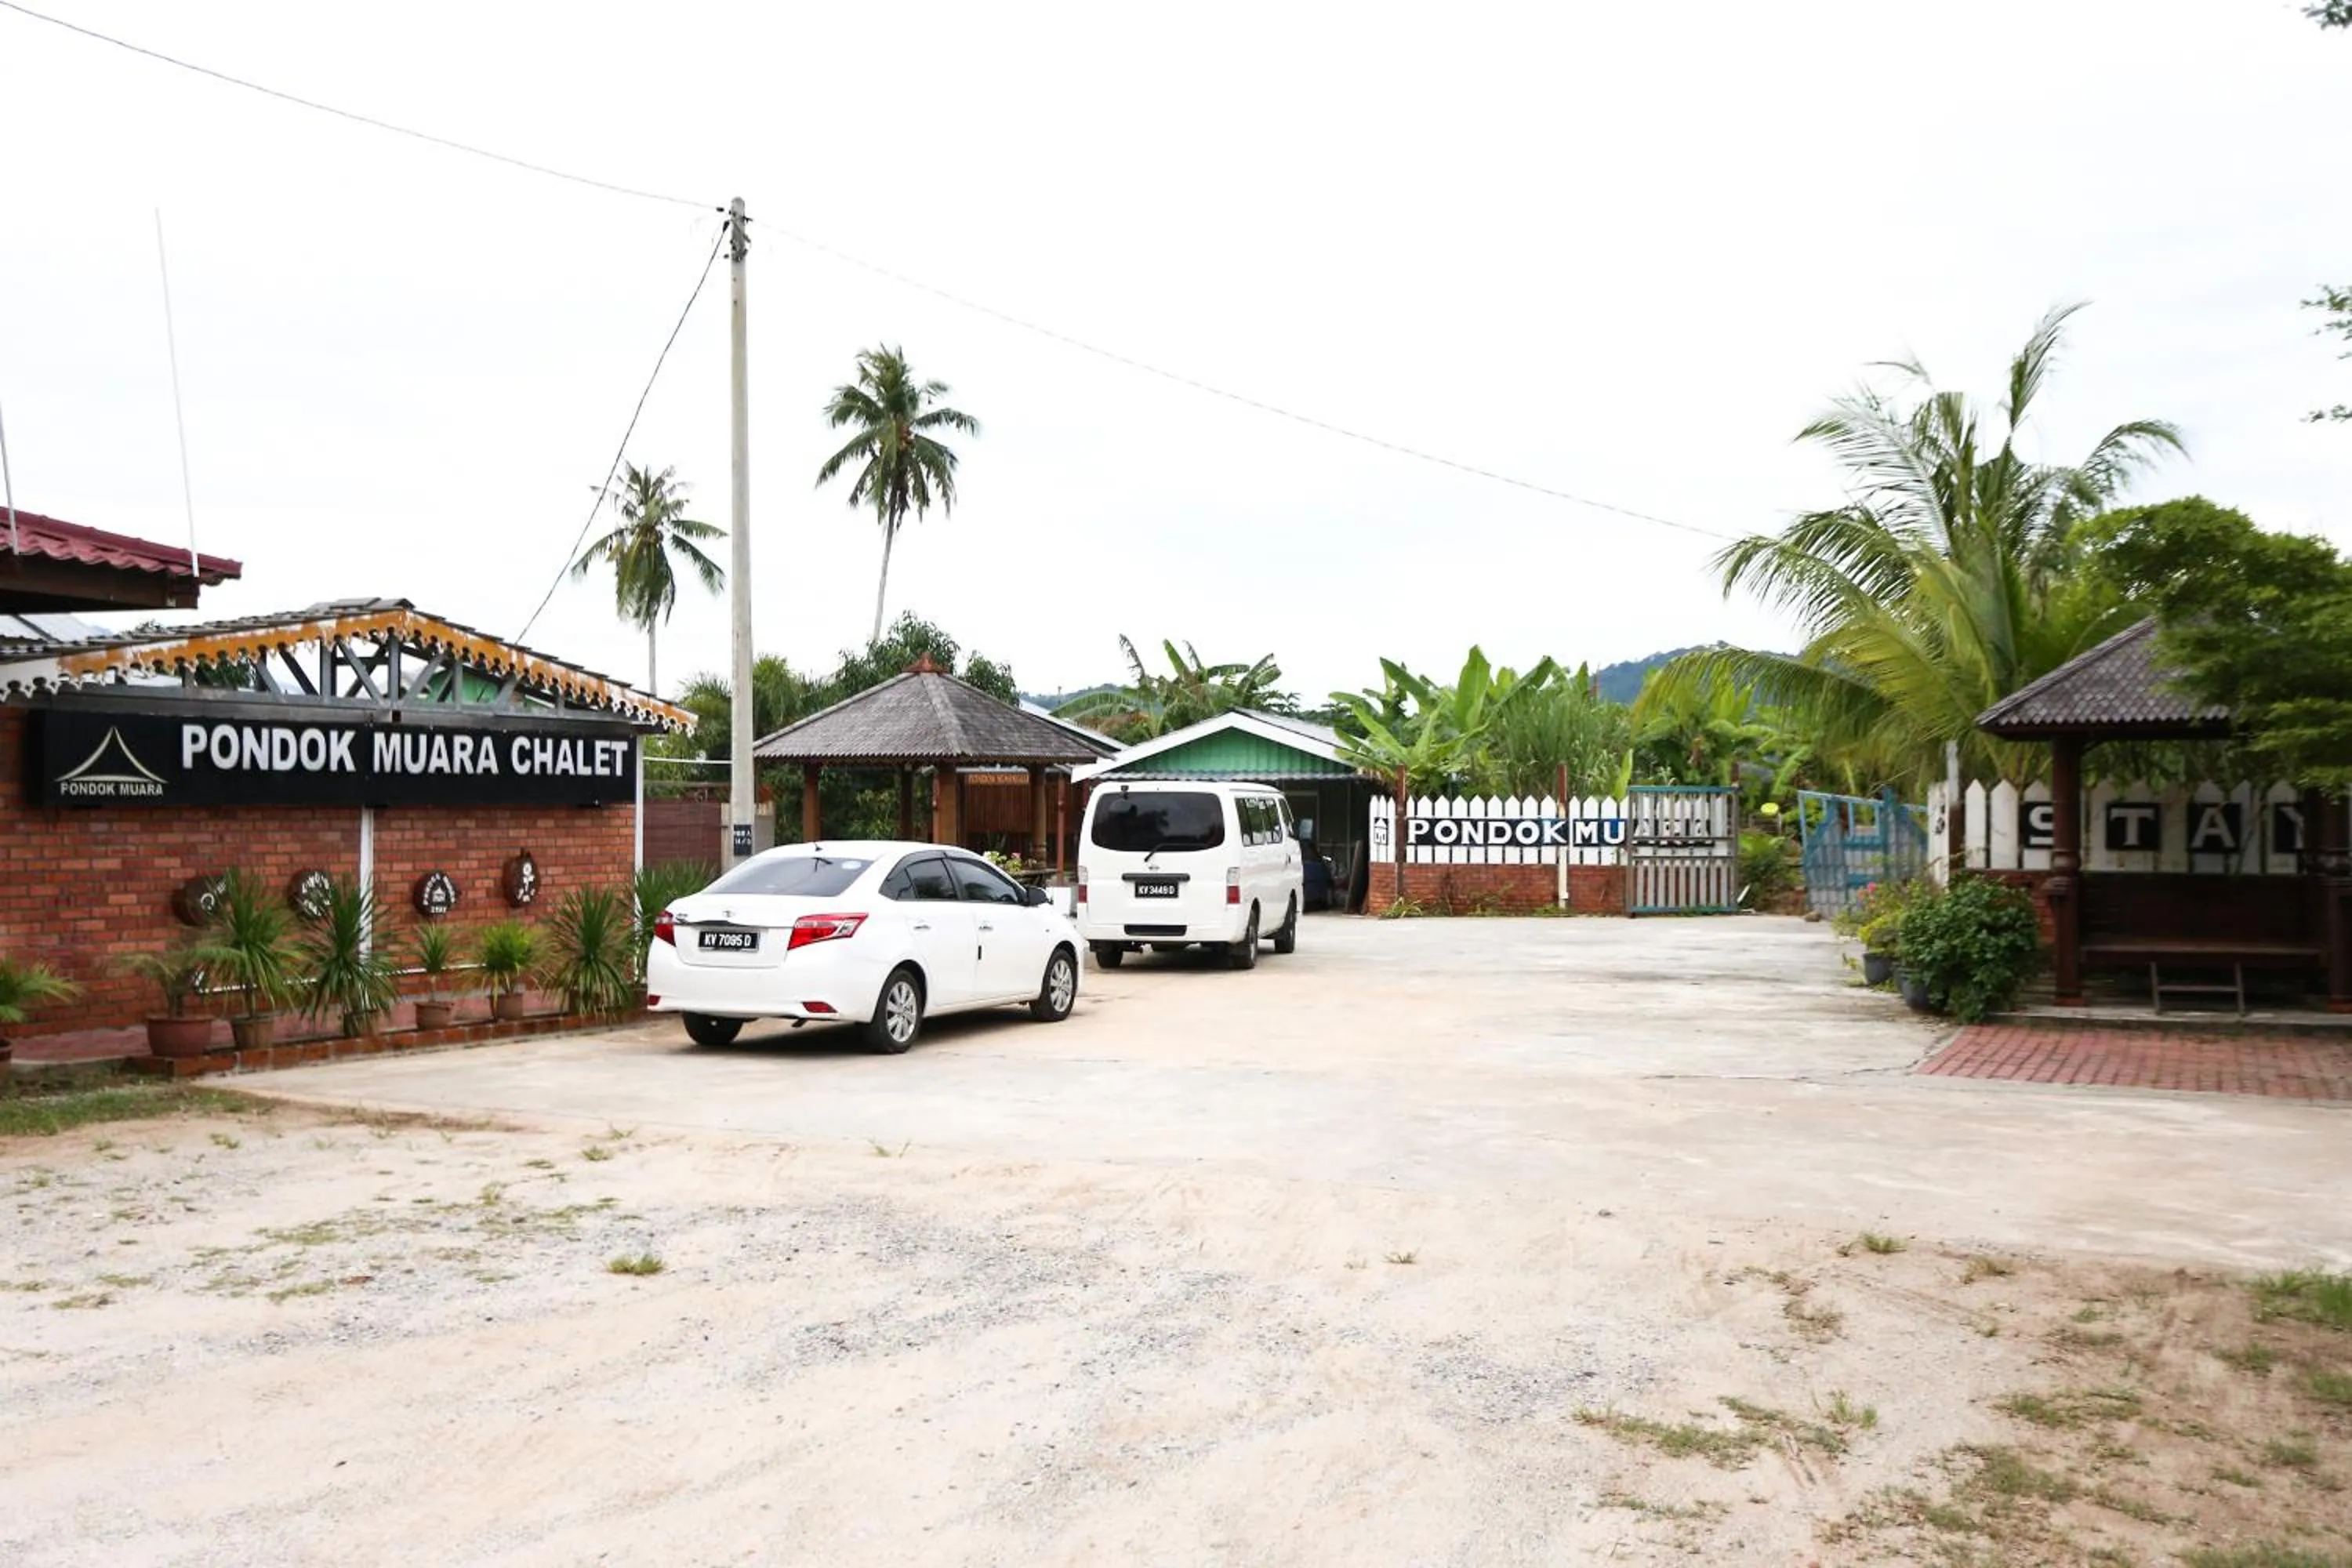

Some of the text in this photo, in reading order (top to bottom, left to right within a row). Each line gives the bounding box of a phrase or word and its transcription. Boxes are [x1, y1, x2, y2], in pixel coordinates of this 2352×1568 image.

[181, 724, 628, 777] PONDOK MUARA CHALET
[60, 782, 164, 796] PONDOK MUARA
[1406, 820, 1567, 845] PONDOK
[744, 934, 752, 946] D
